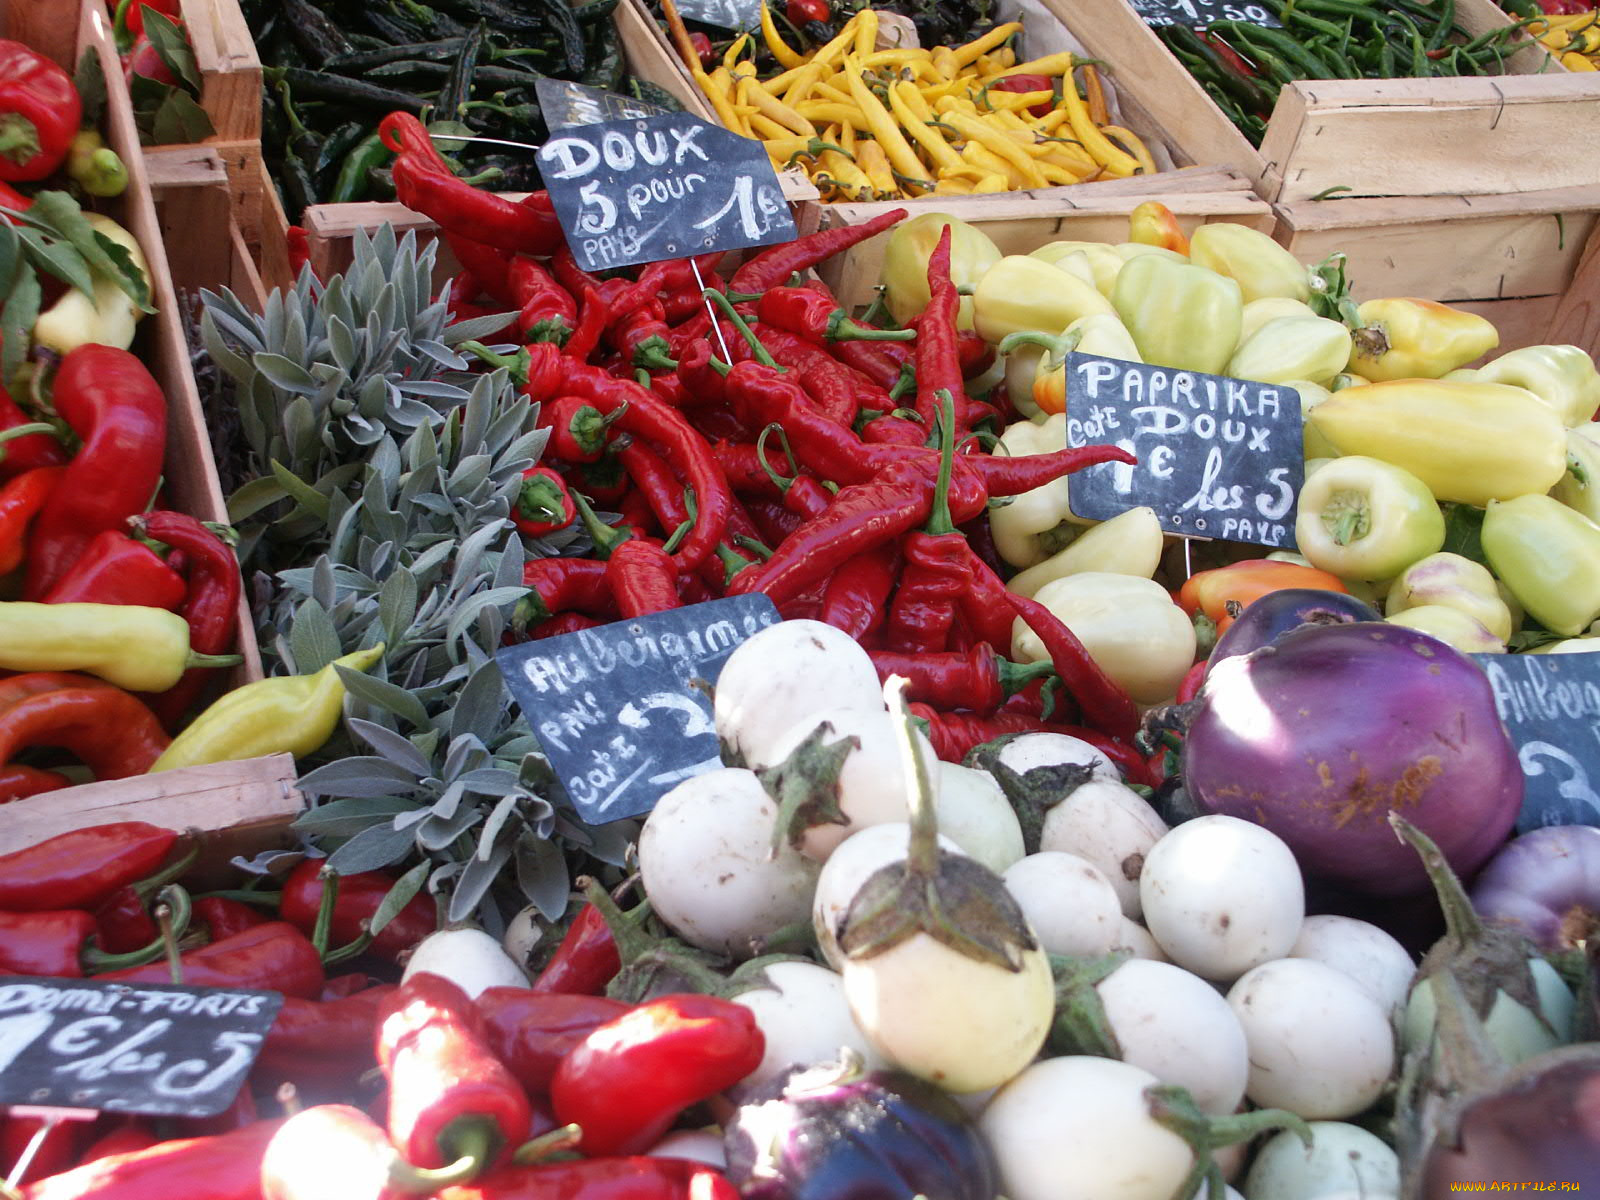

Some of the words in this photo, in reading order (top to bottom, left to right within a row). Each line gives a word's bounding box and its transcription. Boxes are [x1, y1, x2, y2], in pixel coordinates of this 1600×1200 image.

[541, 125, 709, 180] DOUX
[579, 180, 618, 234] 5
[627, 173, 707, 221] pour
[1078, 361, 1280, 420] PAPRIKA
[1131, 405, 1271, 453] DOUX
[1255, 467, 1295, 521] 5
[1222, 517, 1286, 547] PAYS
